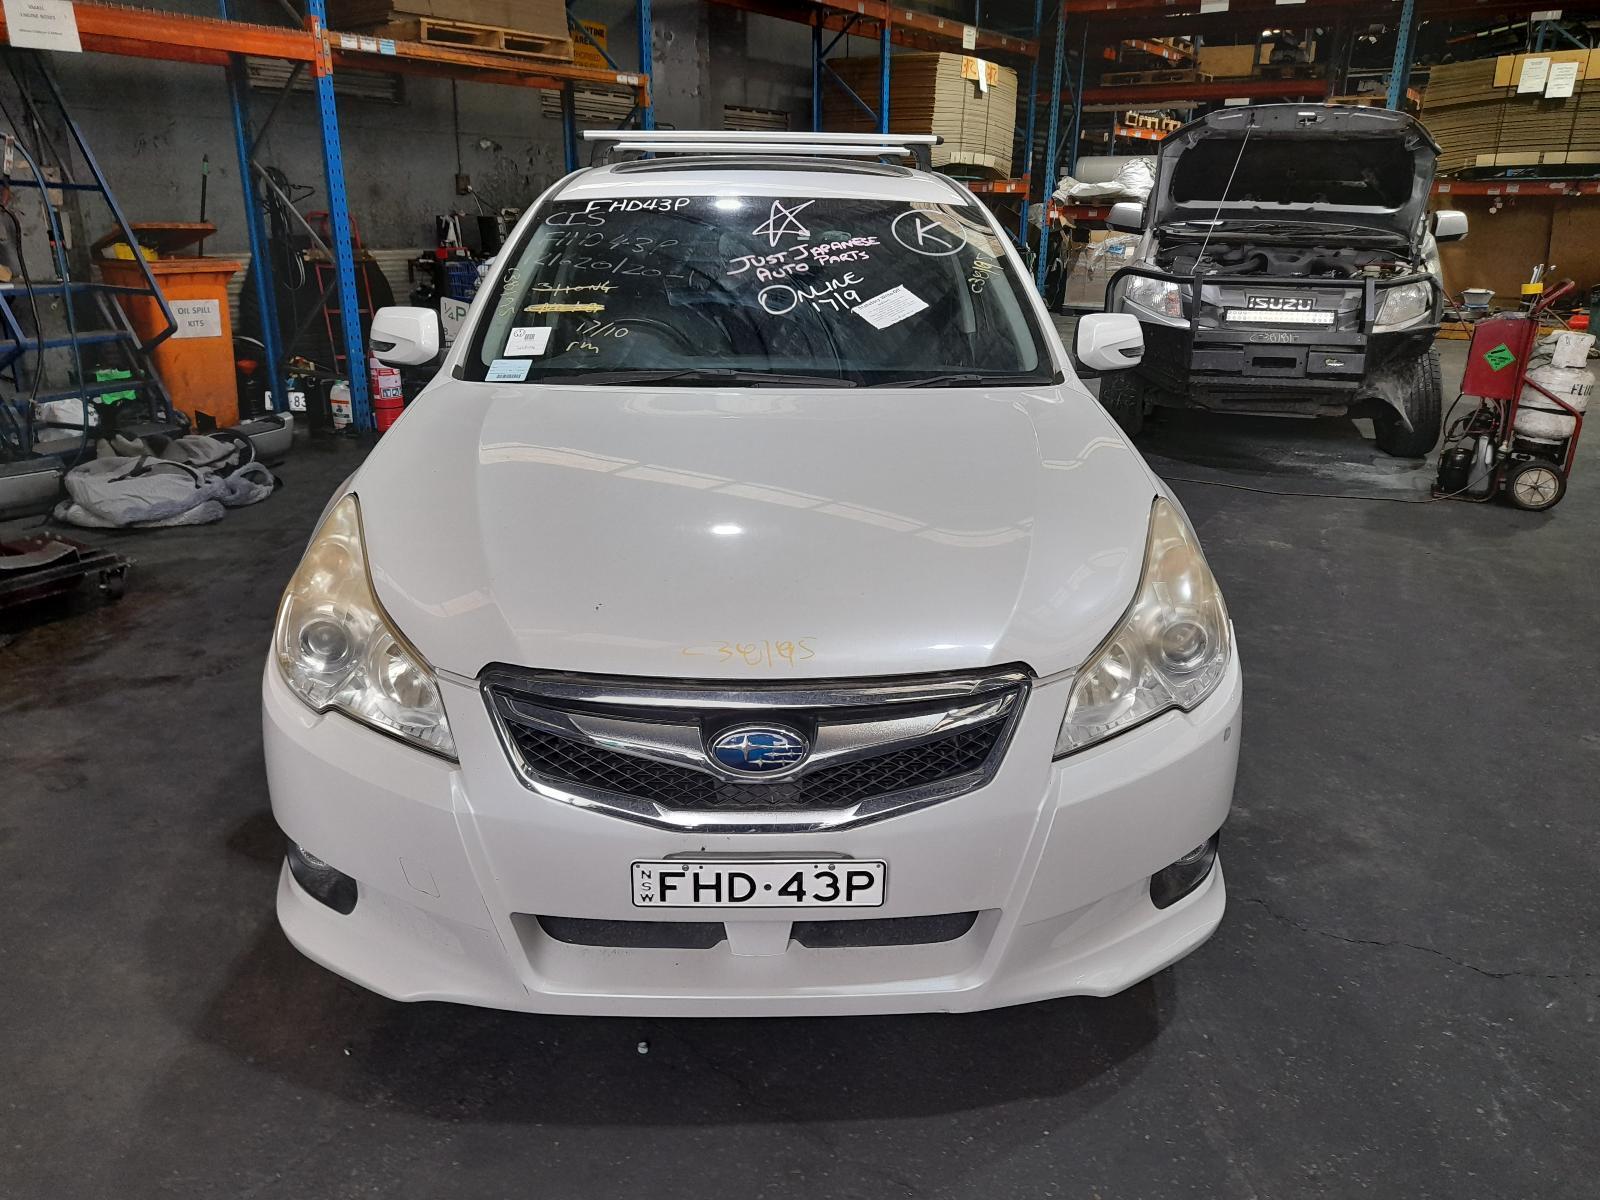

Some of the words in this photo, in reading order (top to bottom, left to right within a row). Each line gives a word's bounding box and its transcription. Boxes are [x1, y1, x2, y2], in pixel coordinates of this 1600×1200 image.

[585, 197, 690, 213] FHD43P
[915, 218, 953, 248] K
[726, 250, 788, 276] JUST
[788, 236, 881, 261] JAPANESE
[756, 262, 810, 282] AUTO
[812, 250, 870, 267] PARTS
[758, 271, 864, 315] ONLINE
[1249, 297, 1312, 311] ISUZU
[177, 307, 190, 315] OIL
[192, 306, 210, 314] SPILL
[187, 319, 205, 327] KITS
